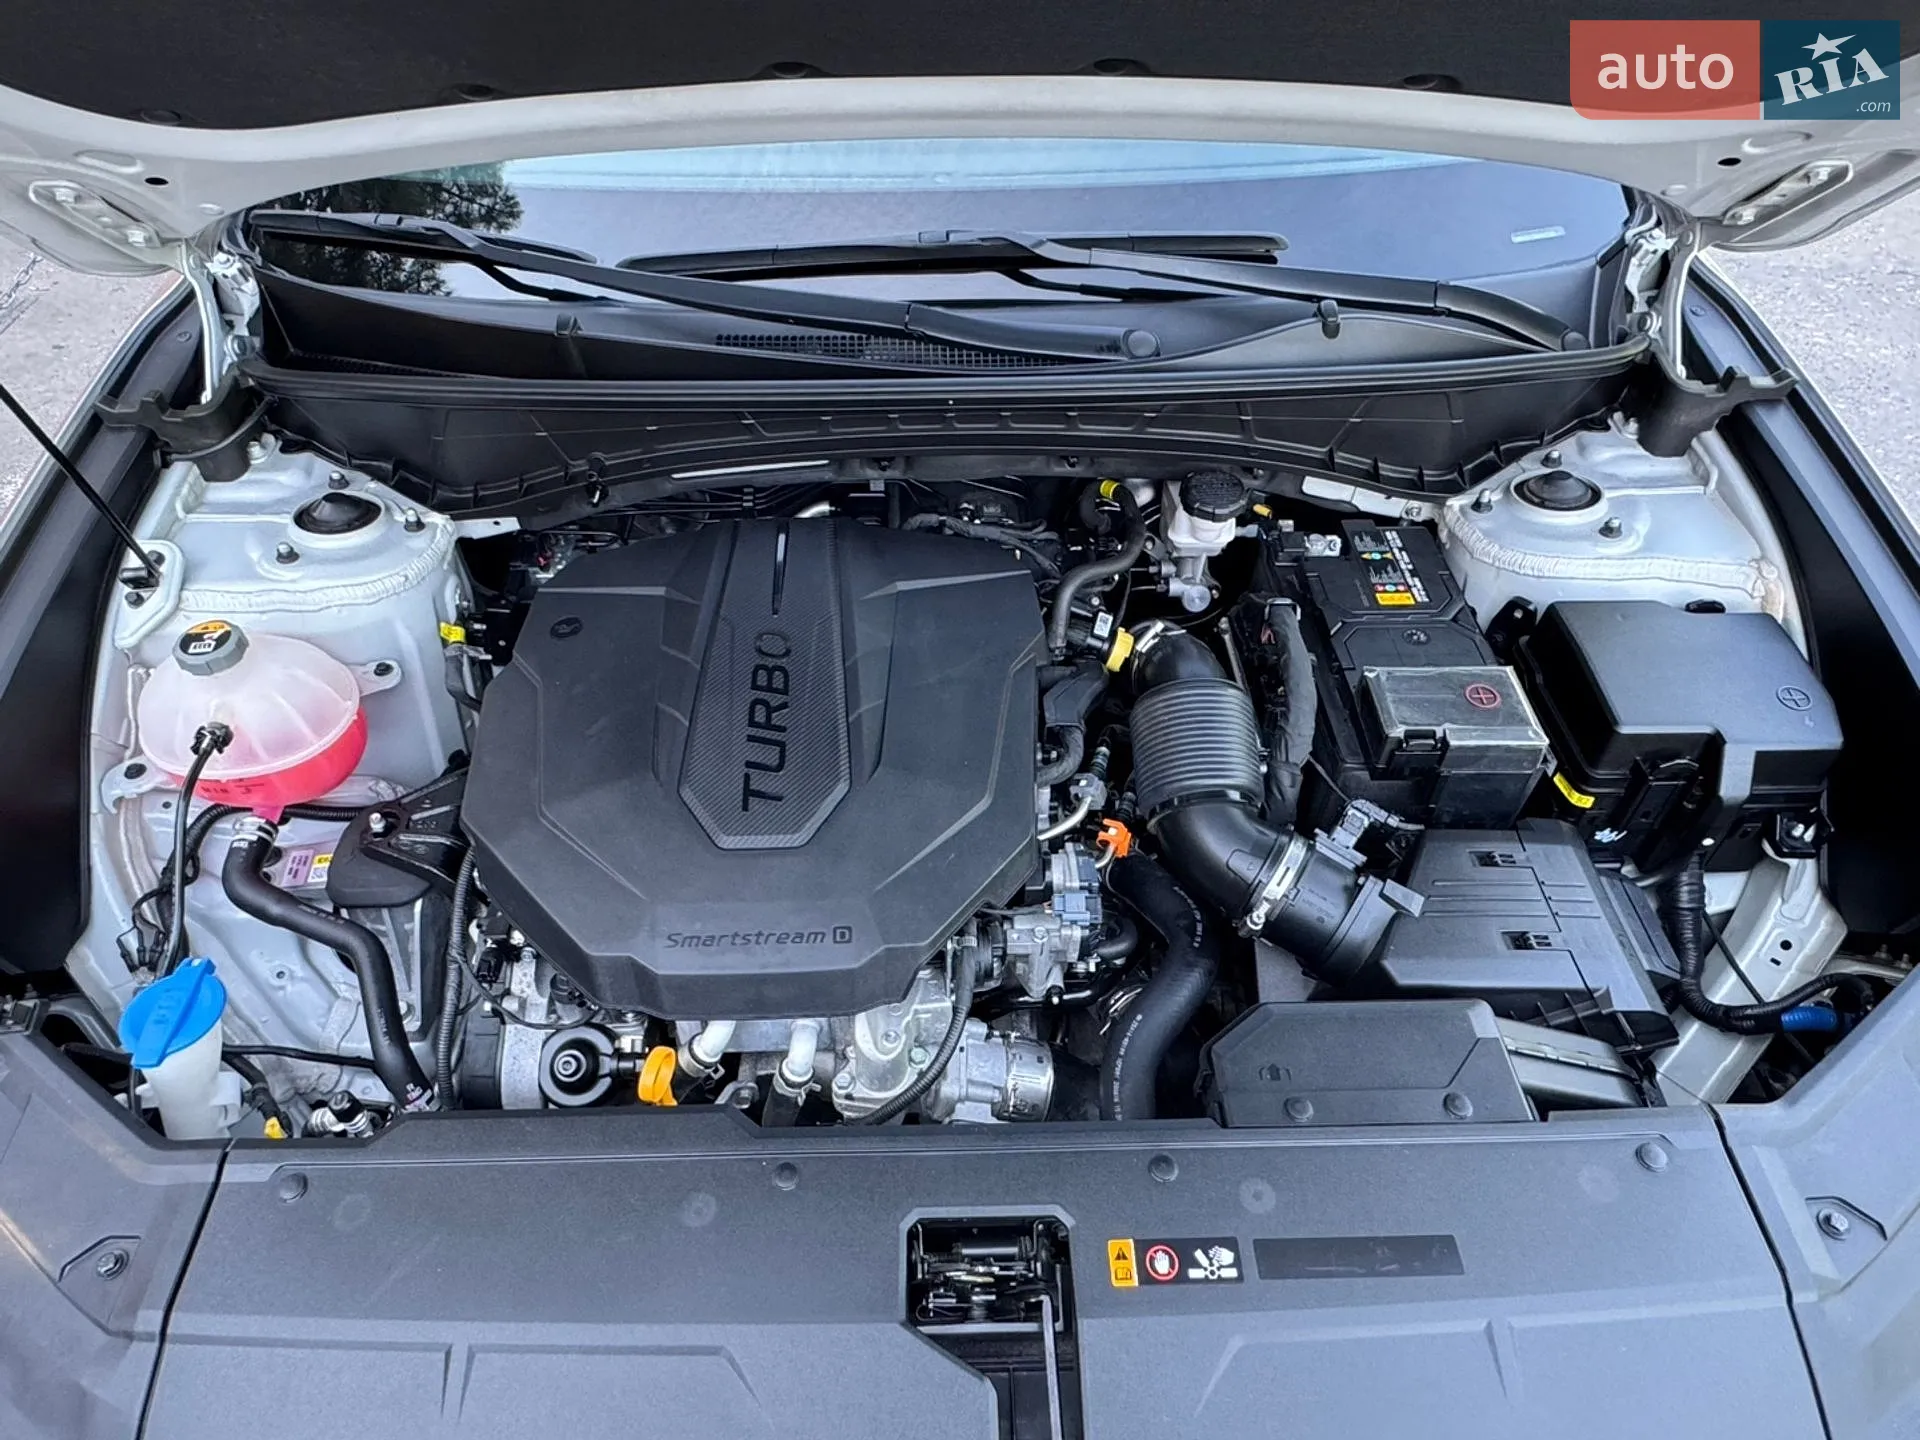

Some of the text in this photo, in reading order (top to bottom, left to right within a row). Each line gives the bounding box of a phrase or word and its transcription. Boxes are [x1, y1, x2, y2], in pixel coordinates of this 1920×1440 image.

[742, 630, 791, 812] TURBO
[664, 926, 853, 949] Smartstream D
